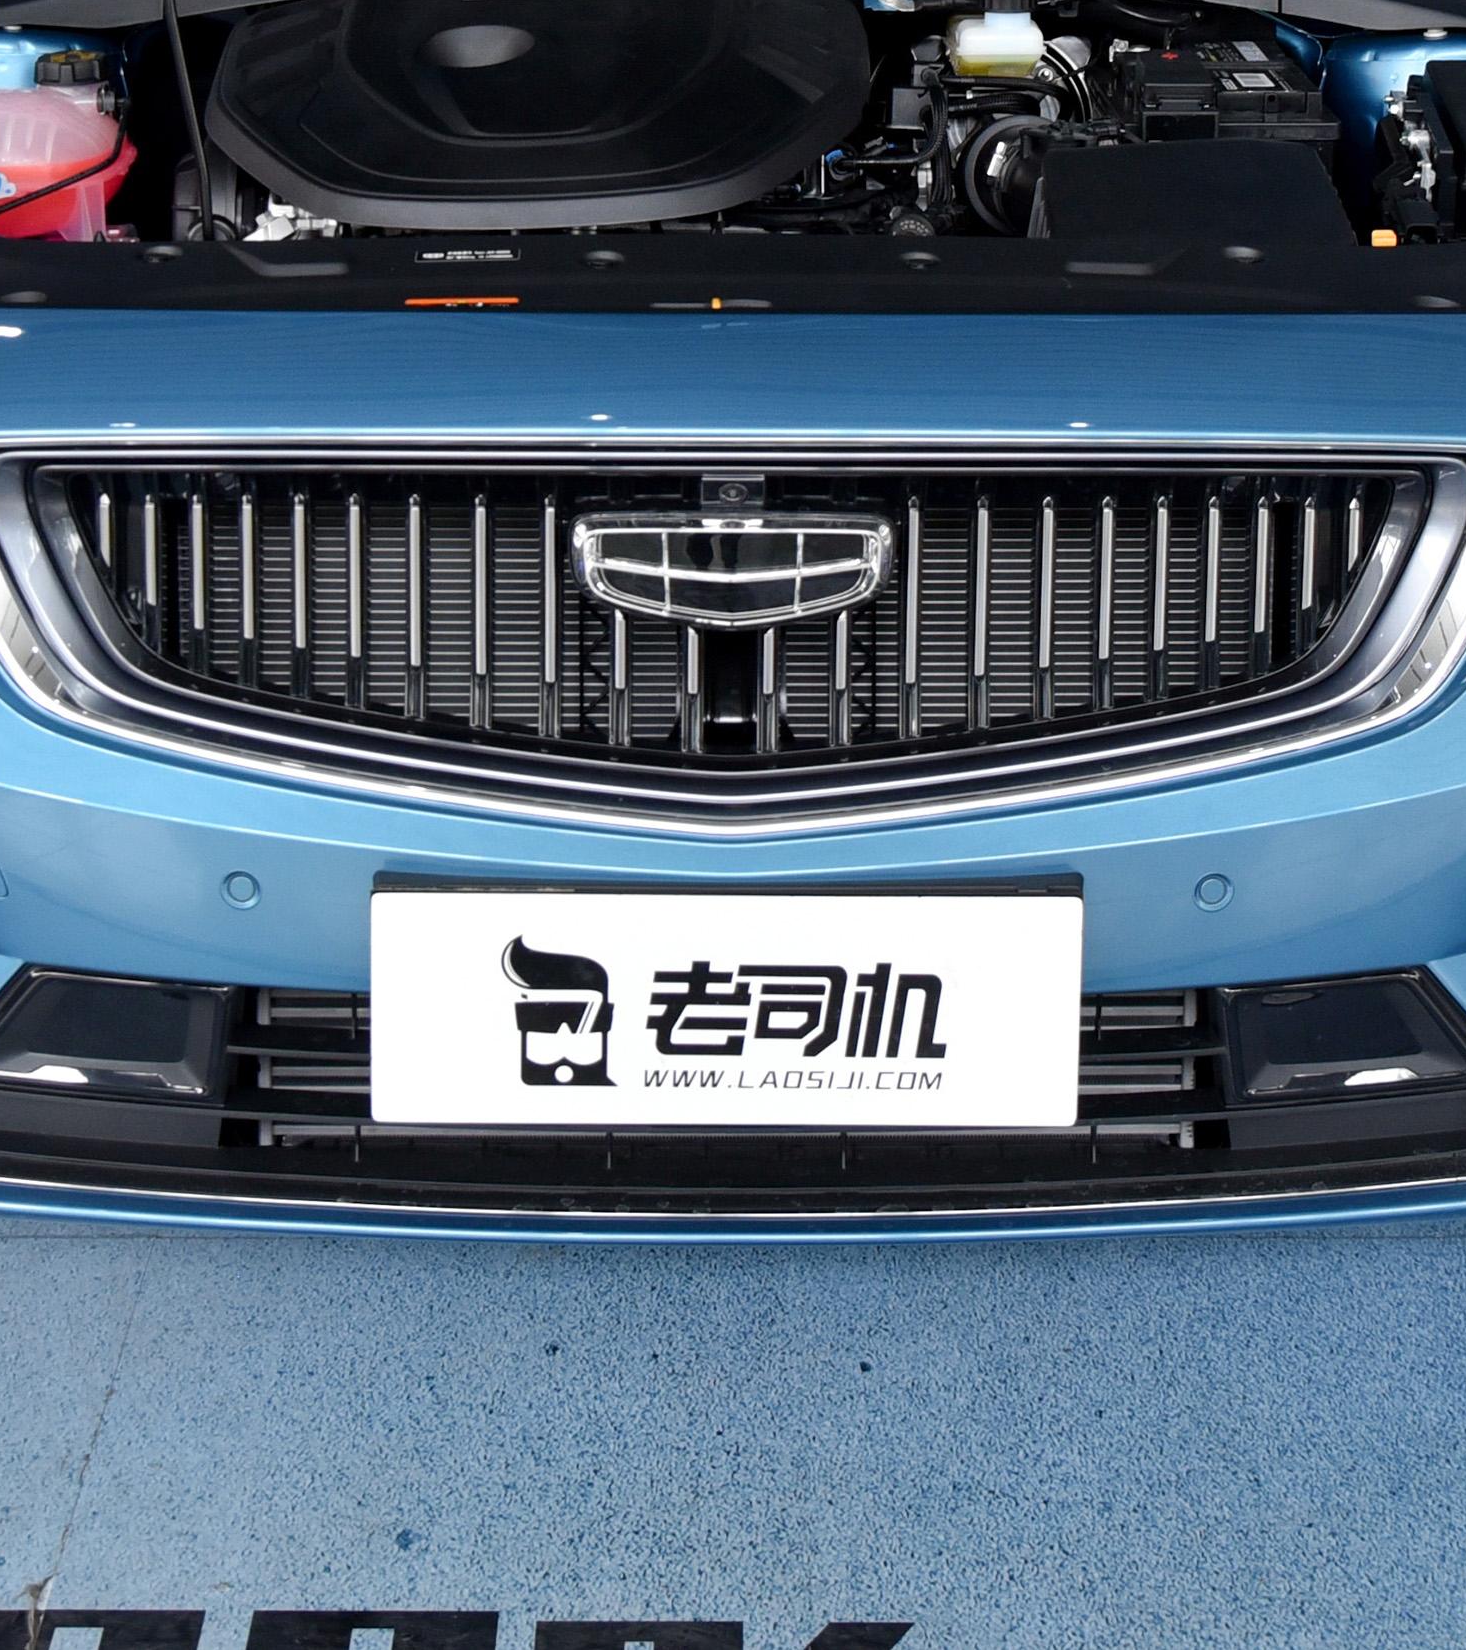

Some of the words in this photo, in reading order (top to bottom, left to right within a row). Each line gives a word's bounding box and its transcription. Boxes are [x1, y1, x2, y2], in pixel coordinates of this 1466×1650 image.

[645, 960, 948, 1060] 老司机
[643, 1068, 944, 1091] WWW.LAOSIJI.COM
